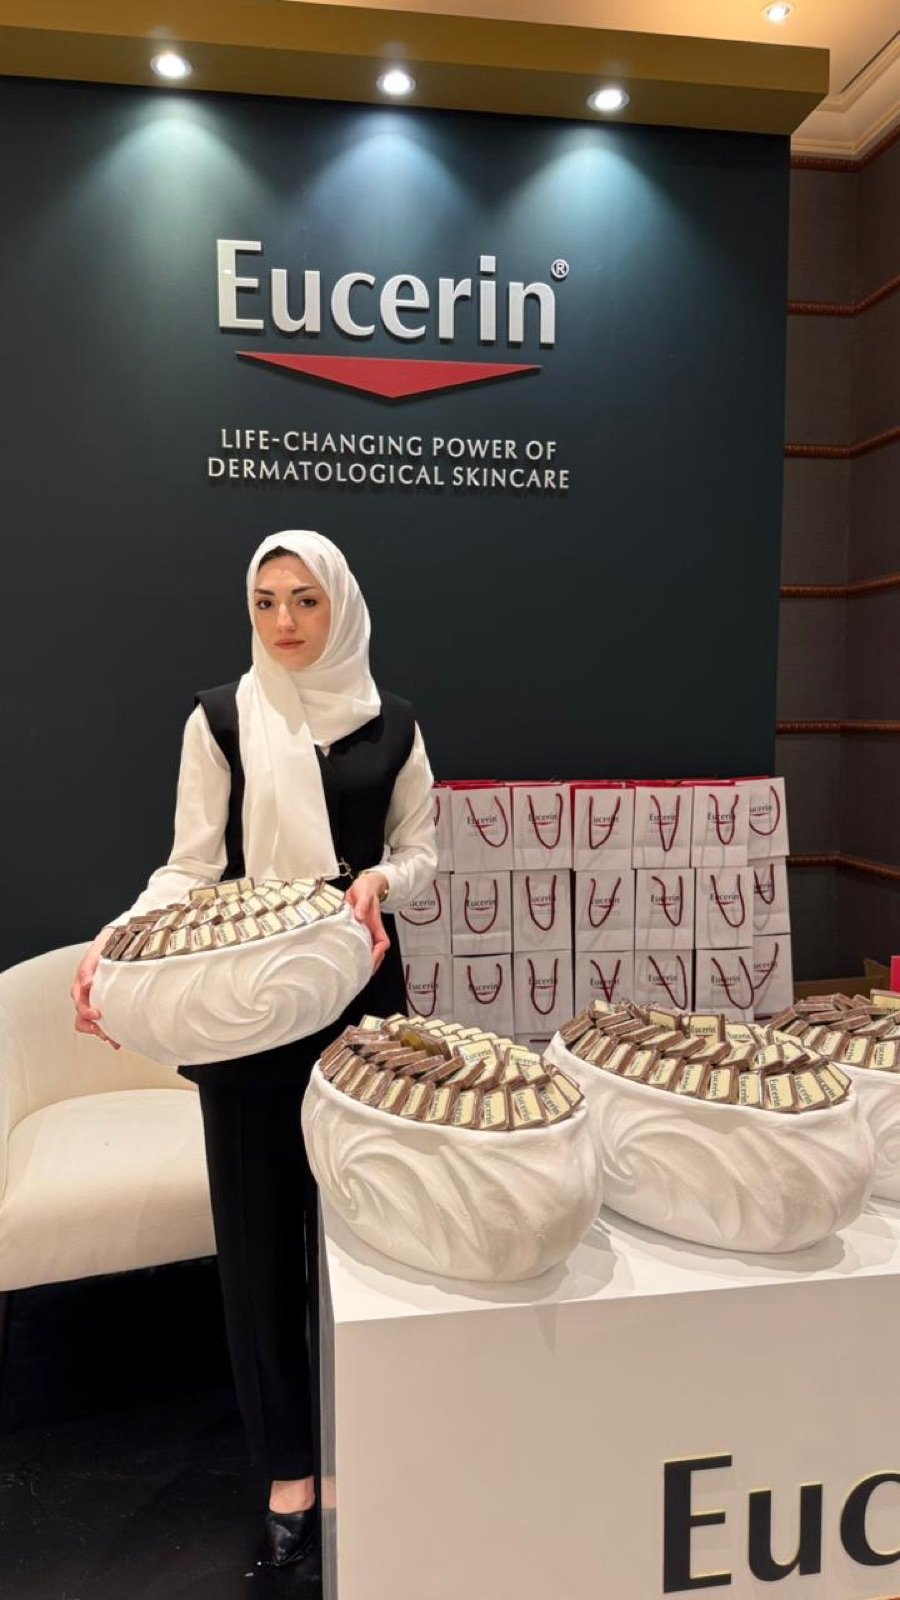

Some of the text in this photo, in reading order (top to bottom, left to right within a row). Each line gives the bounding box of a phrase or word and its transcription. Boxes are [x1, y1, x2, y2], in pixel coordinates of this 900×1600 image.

[221, 428, 556, 460] LIFE-CHANGING POWER OF
[207, 458, 570, 489] DERMATOLOGICAL SKINCARE
[409, 898, 435, 907] ucerin
